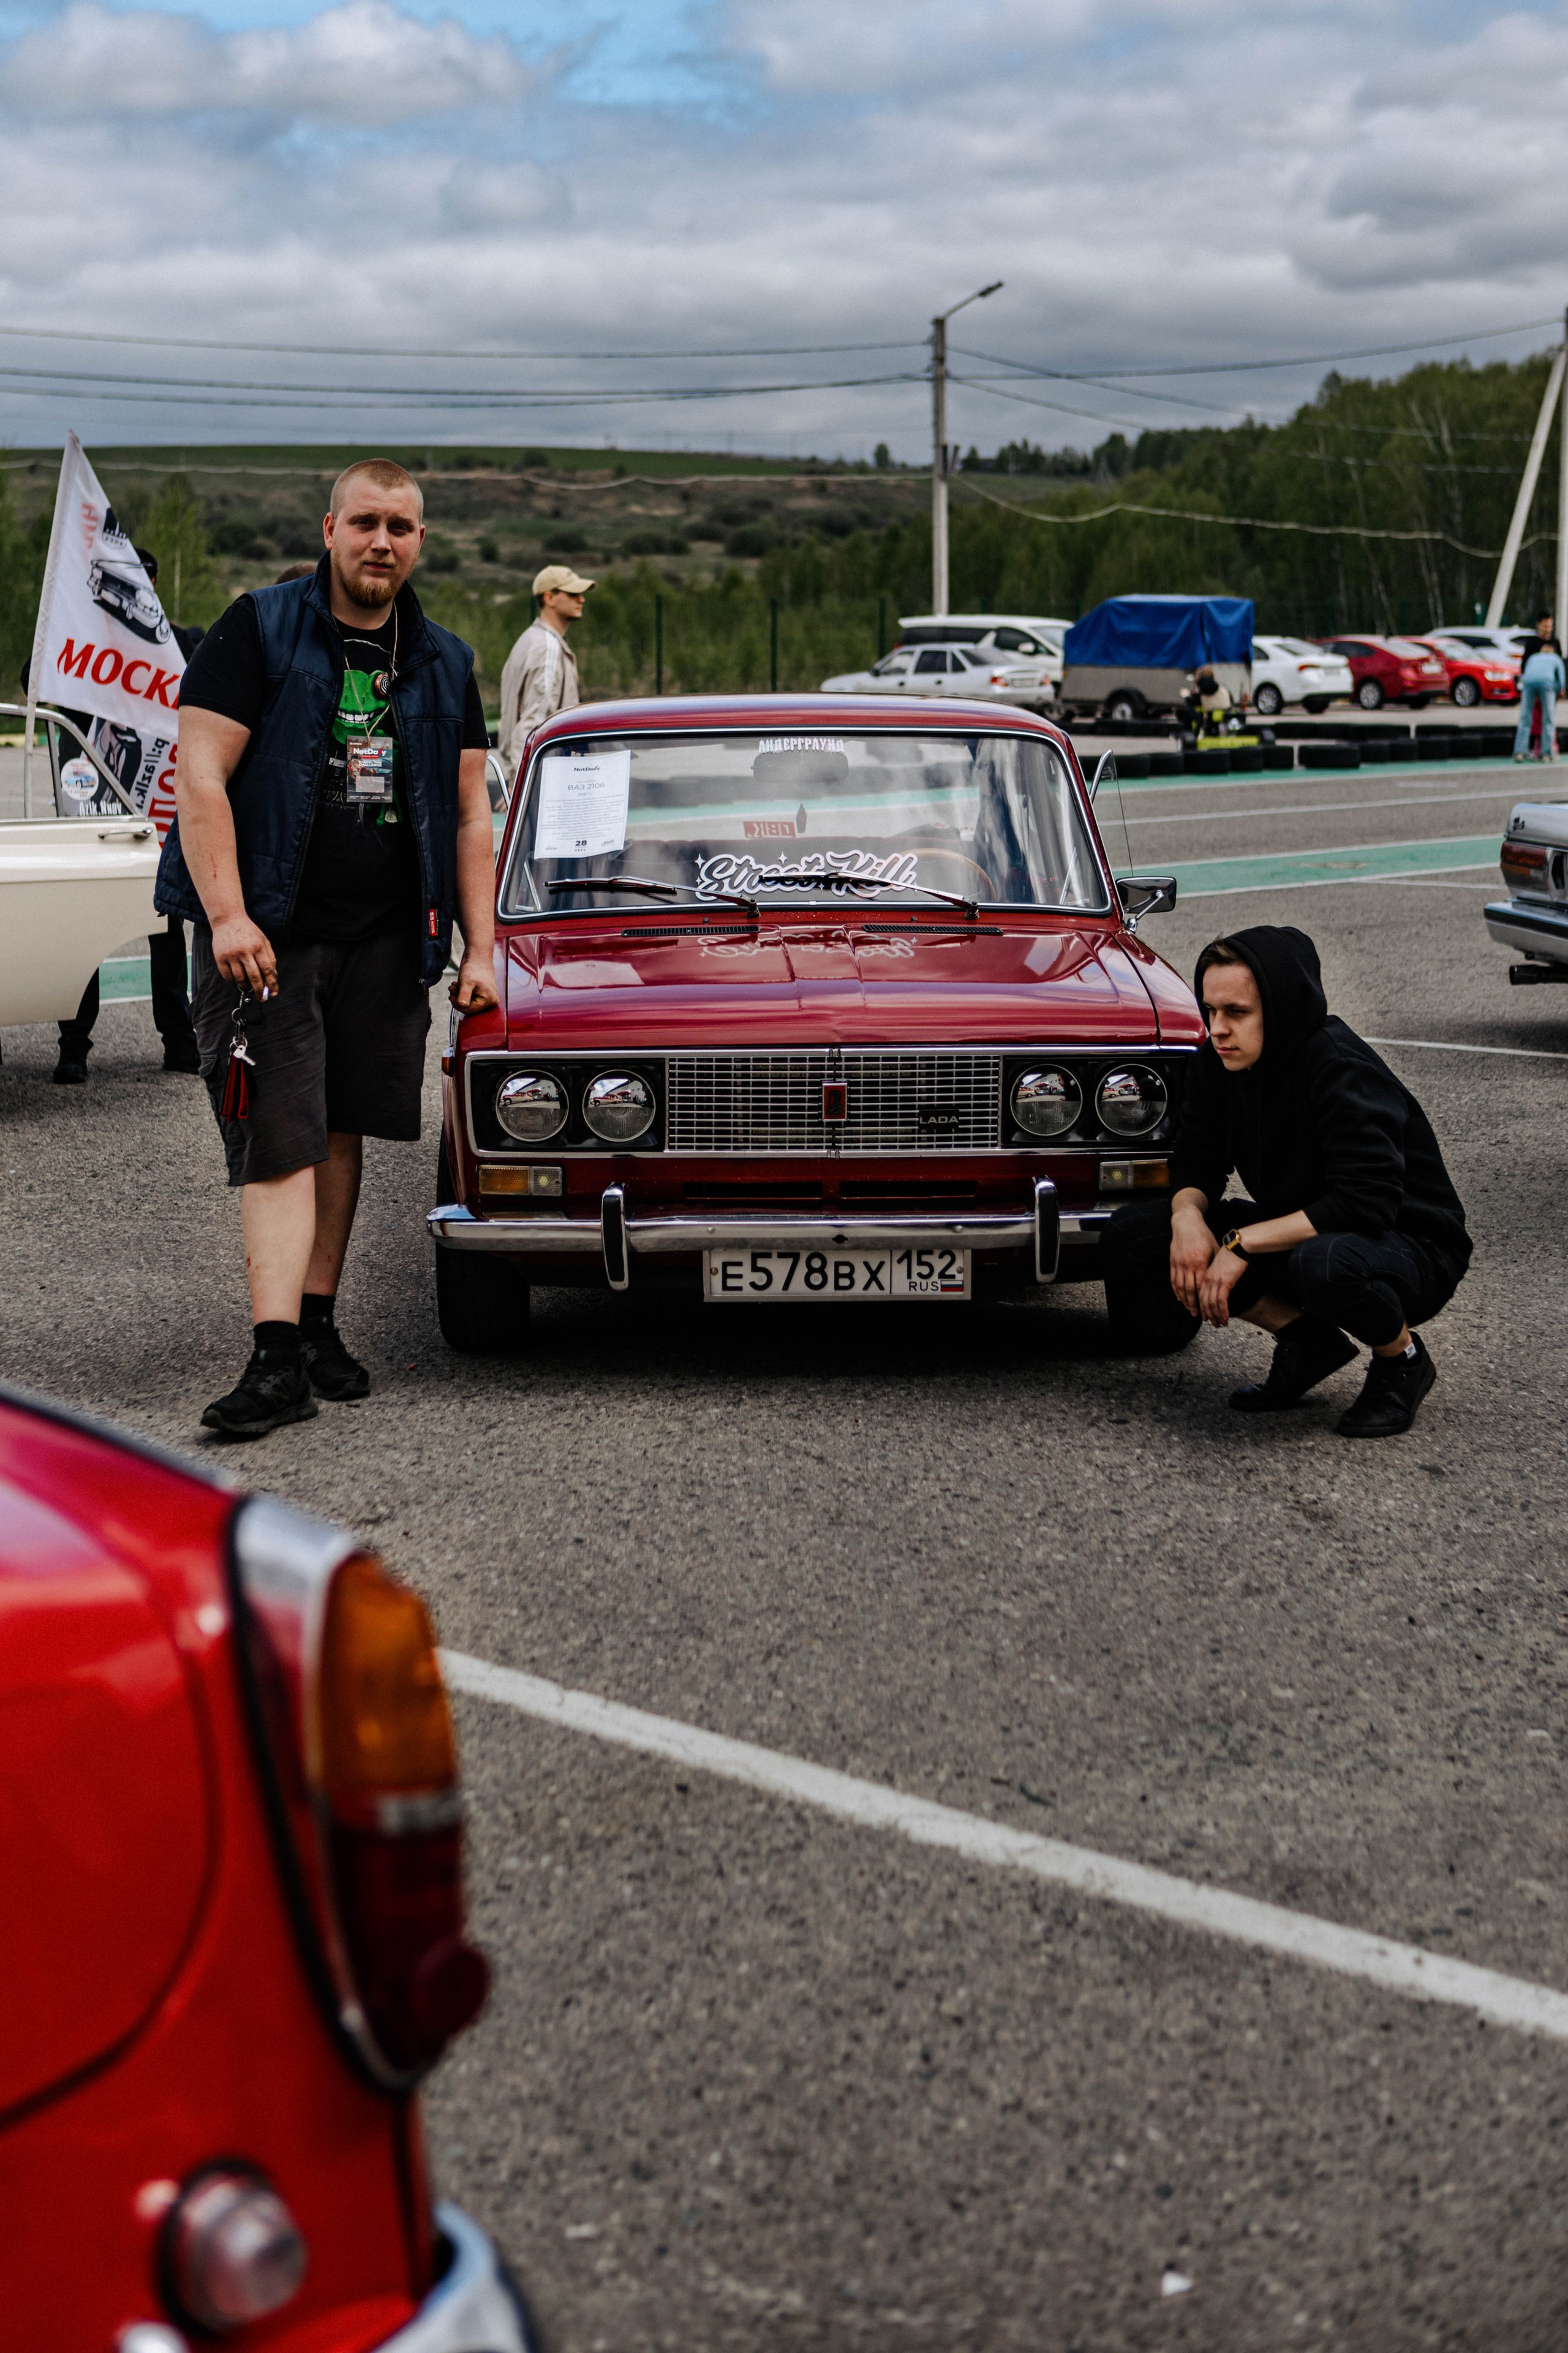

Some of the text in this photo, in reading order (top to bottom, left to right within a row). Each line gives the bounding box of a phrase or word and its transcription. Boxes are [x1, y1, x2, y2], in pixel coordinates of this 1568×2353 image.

[57, 638, 179, 711] МОСК
[758, 738, 845, 753] АНДЕРГРАУНД
[919, 1116, 959, 1124] LADA
[896, 1250, 956, 1280] 152
[908, 1281, 940, 1291] RUS
